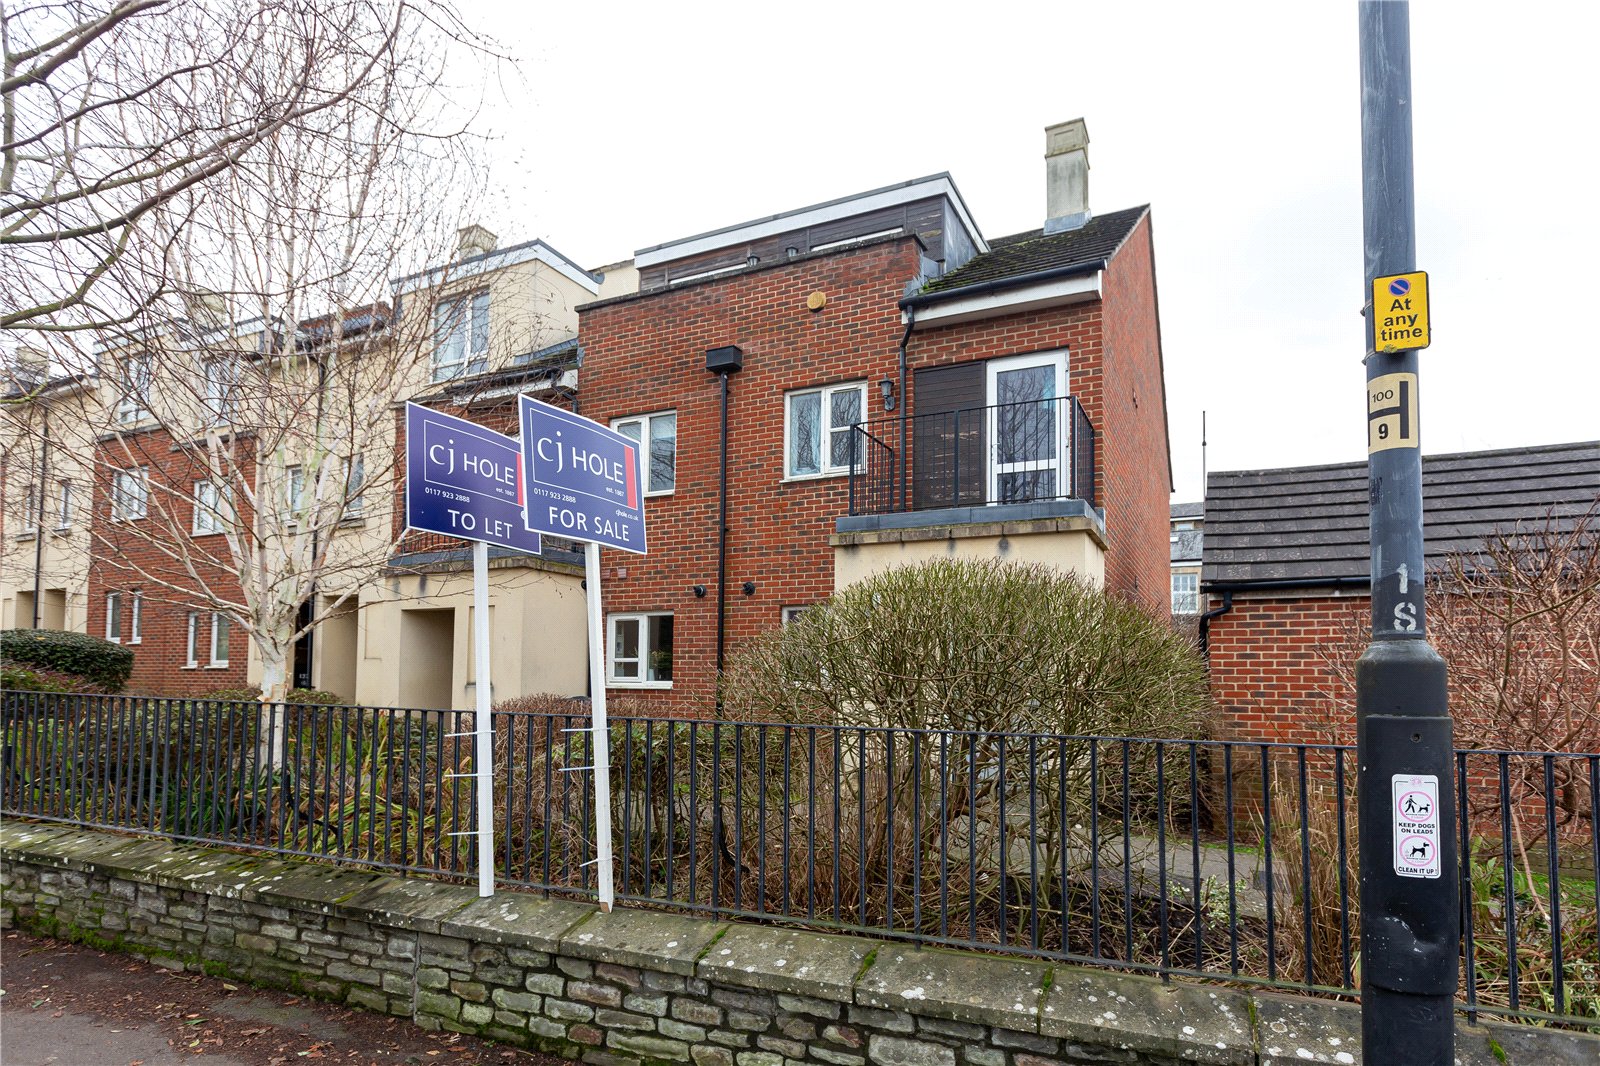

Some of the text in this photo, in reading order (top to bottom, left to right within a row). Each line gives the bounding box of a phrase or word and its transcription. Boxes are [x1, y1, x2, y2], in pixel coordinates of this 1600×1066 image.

[1390, 298, 1412, 312] At
[1383, 313, 1419, 327] any
[1380, 327, 1423, 342] time
[1371, 389, 1394, 403] 100
[1378, 423, 1389, 440] 9
[463, 452, 515, 486] HOLE
[572, 446, 624, 485] HOLE
[424, 486, 471, 503] 0117 923 2888
[533, 487, 577, 504] 0117 923 2888
[447, 509, 513, 540] TO LET
[548, 506, 630, 542] FOR SALE
[1398, 866, 1418, 874] CLEAN
